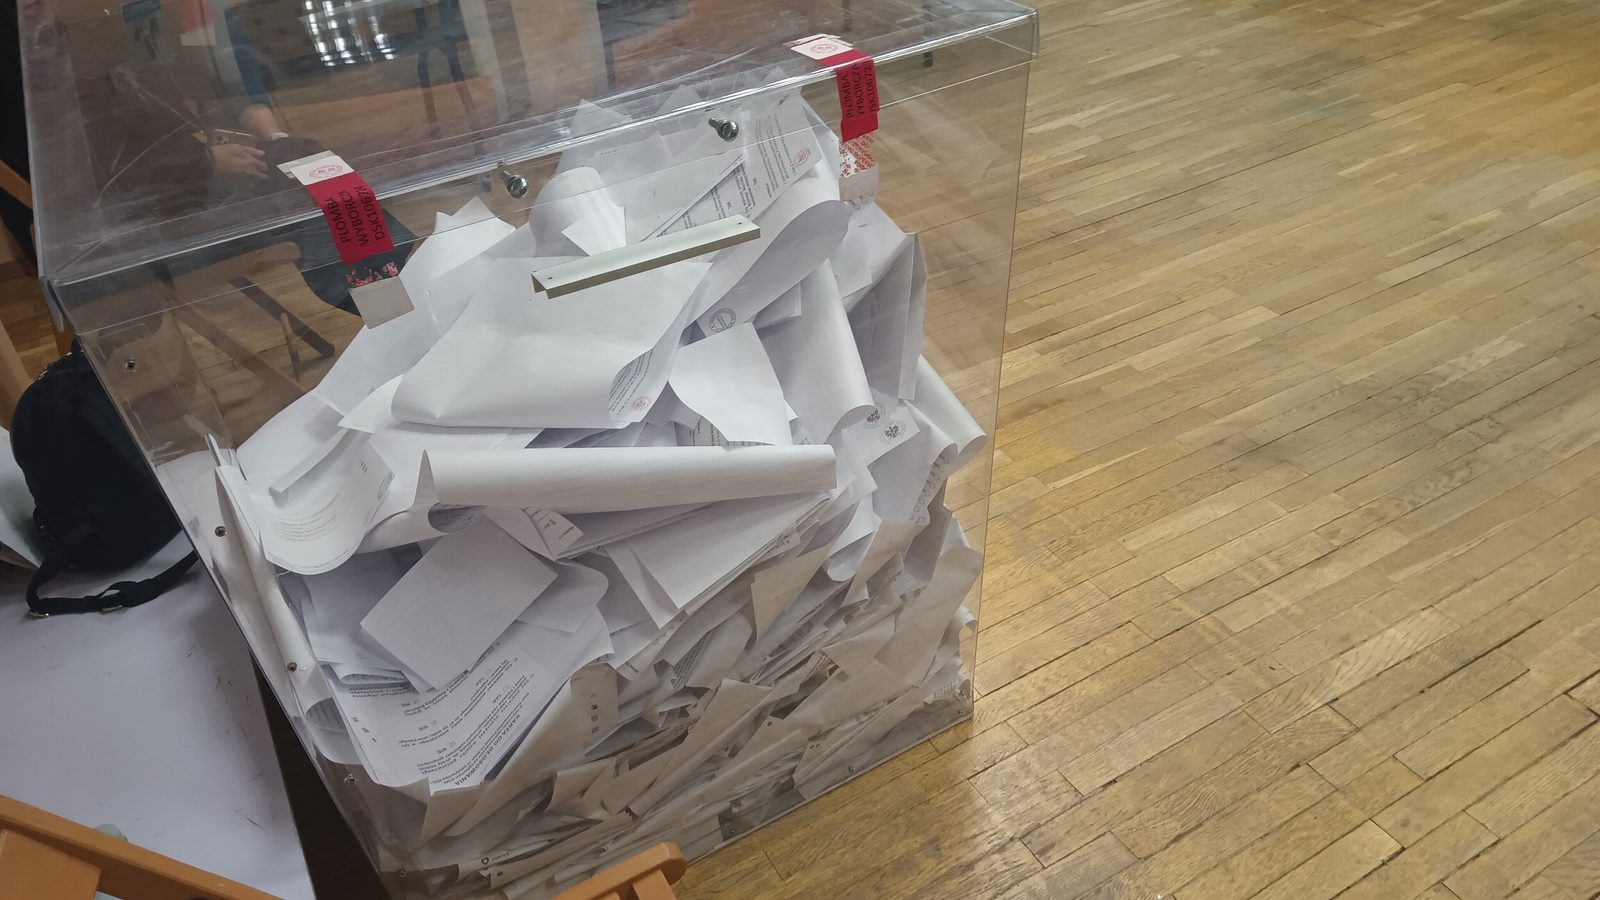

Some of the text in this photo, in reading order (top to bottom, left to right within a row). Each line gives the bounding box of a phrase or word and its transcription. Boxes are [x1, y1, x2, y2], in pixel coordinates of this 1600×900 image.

[841, 73, 854, 118] PLOMBA
[324, 196, 352, 244] PLOMBA
[493, 736, 503, 746] DO
[501, 714, 521, 735] KARTA
[454, 746, 494, 786] GŁOSOWANIA
